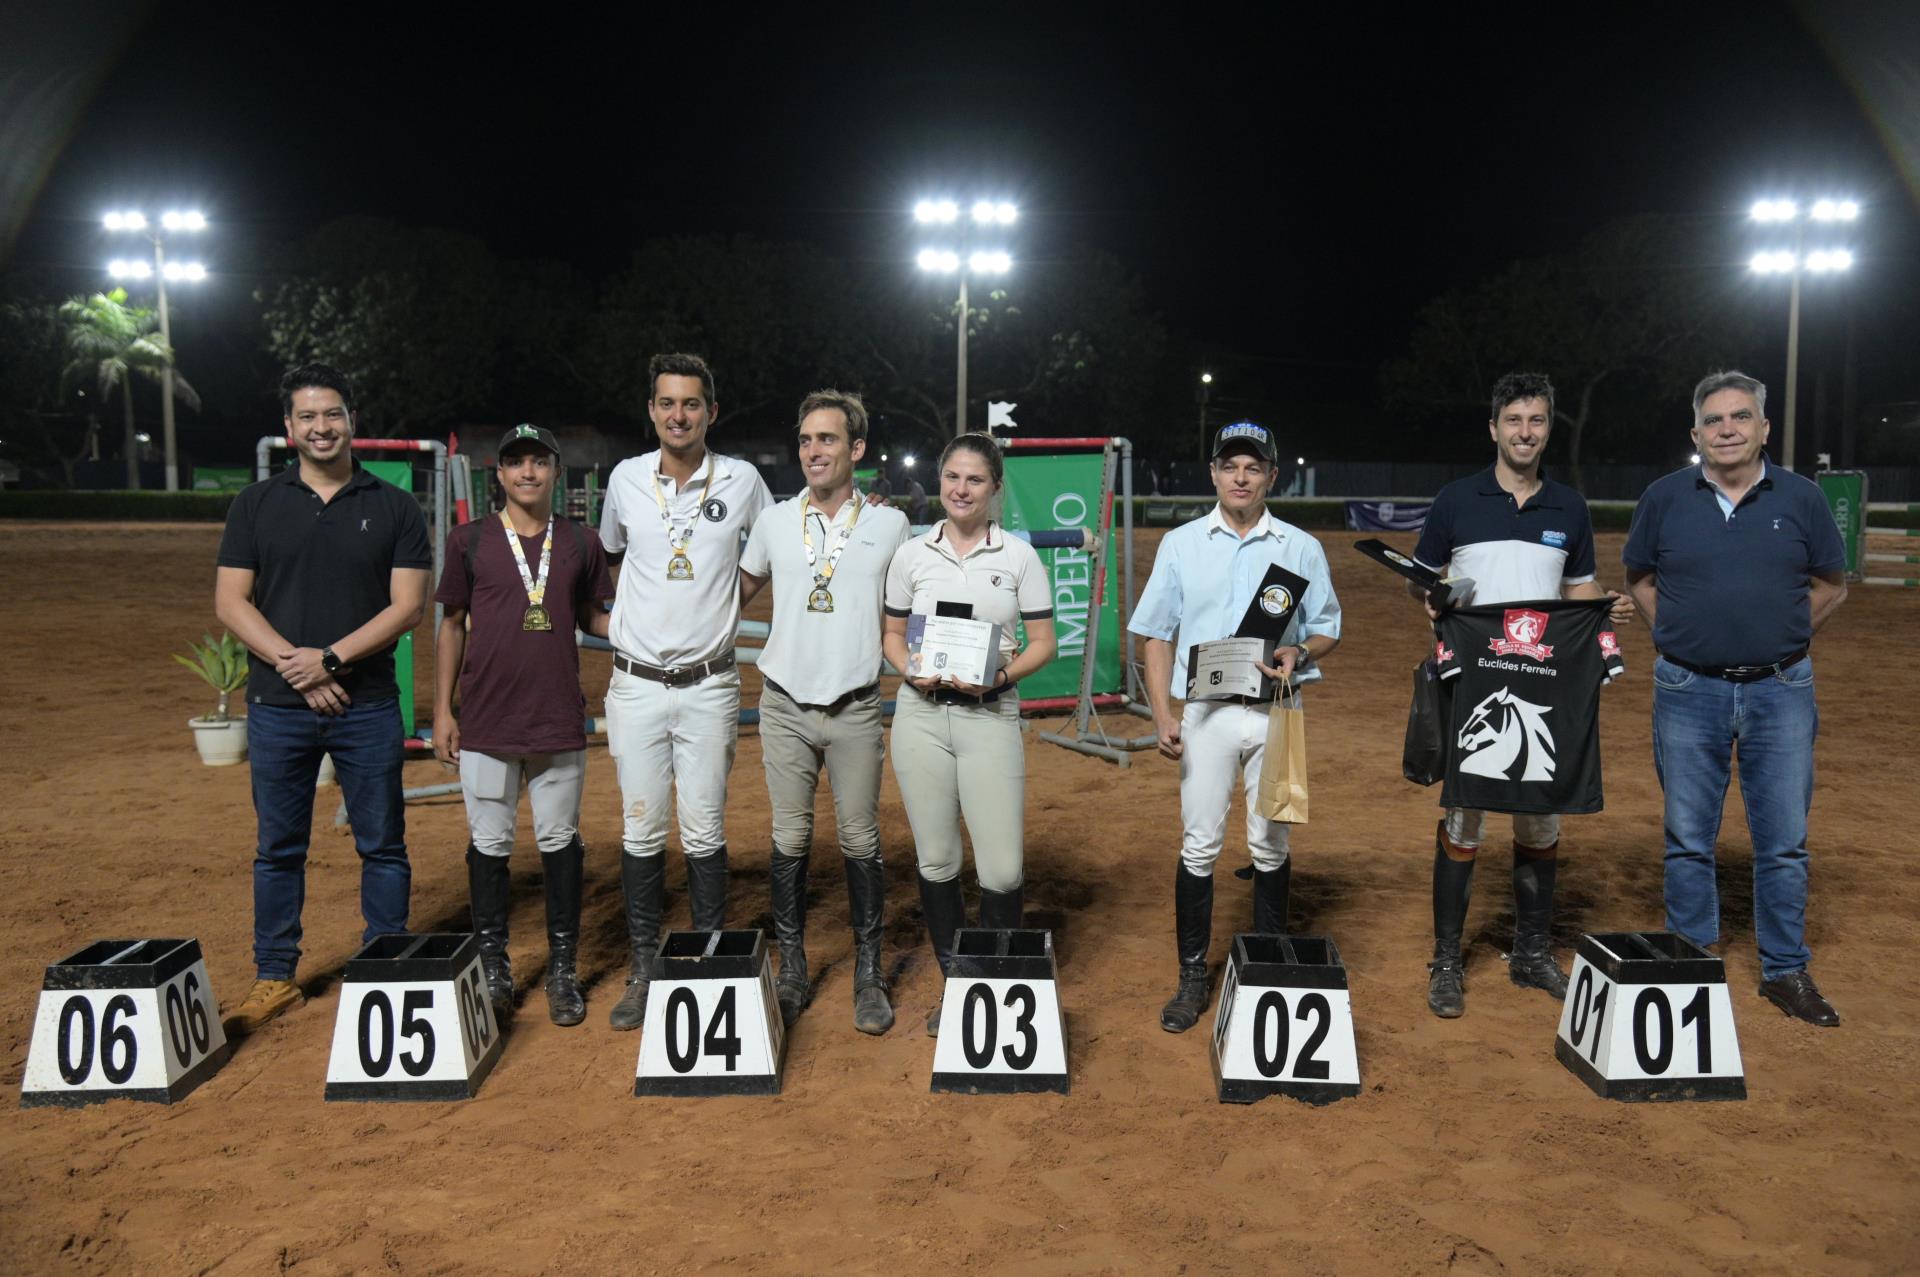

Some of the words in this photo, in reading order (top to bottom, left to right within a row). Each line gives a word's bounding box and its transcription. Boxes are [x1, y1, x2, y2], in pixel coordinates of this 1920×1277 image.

[1477, 658, 1519, 672] Euclides
[1520, 663, 1557, 676] Ferreira
[57, 994, 138, 1085] 06
[165, 971, 210, 1069] 06
[357, 989, 436, 1078] 05
[461, 965, 490, 1061] 05
[664, 985, 742, 1073] 04
[962, 982, 1038, 1070] 03
[1252, 990, 1331, 1080] 02
[1569, 964, 1611, 1064] 01
[1632, 986, 1713, 1076] 01
